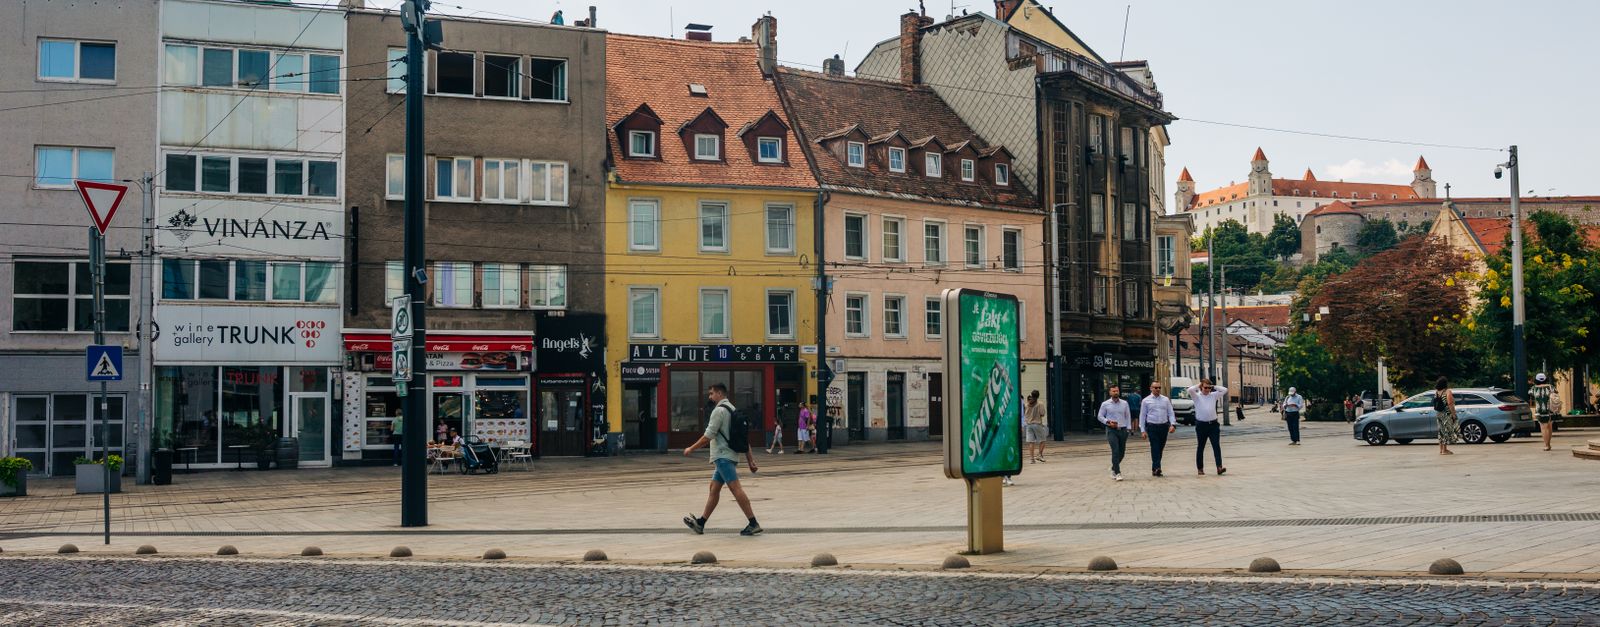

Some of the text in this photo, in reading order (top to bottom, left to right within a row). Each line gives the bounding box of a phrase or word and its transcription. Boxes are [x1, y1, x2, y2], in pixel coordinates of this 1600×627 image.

[174, 322, 214, 333] wine
[174, 334, 214, 346] gallery
[217, 326, 295, 344] TRUNK
[633, 345, 710, 361] AVENUE
[719, 348, 727, 359] 10
